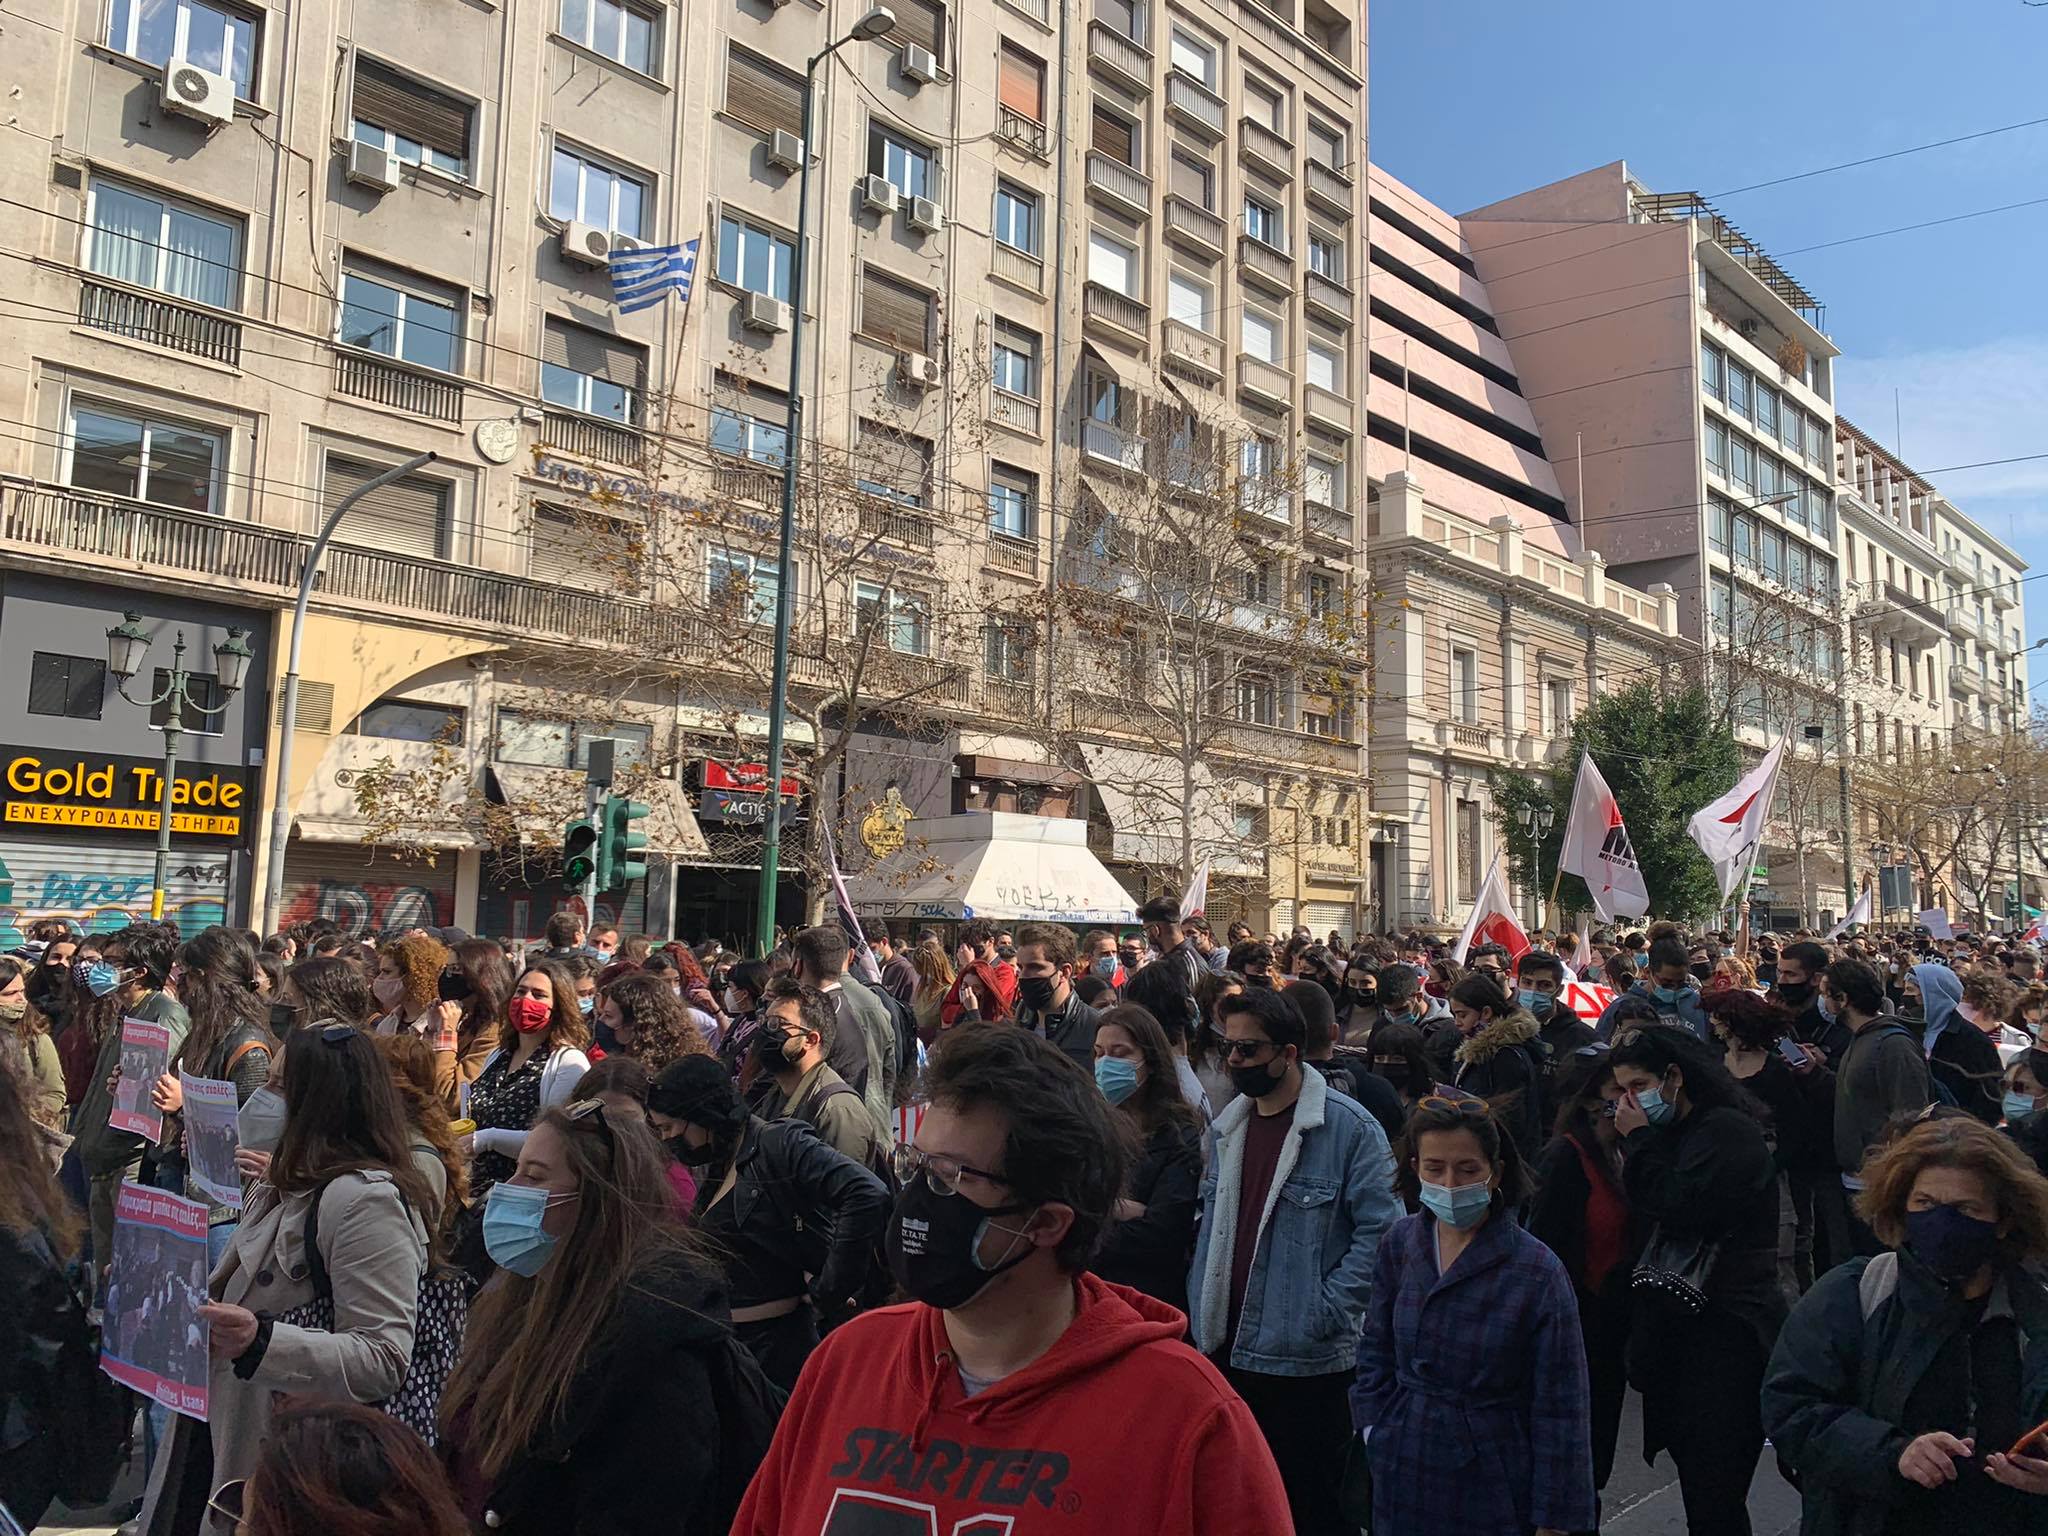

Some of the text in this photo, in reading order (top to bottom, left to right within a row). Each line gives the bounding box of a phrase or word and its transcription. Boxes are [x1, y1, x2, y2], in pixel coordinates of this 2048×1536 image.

[7, 757, 243, 809] Gold Trade
[10, 805, 236, 832] ΕΝΕΧΥΡΟΔΑΝΕΣΤΗΡΙΑ
[829, 1427, 1070, 1508] STARTER
